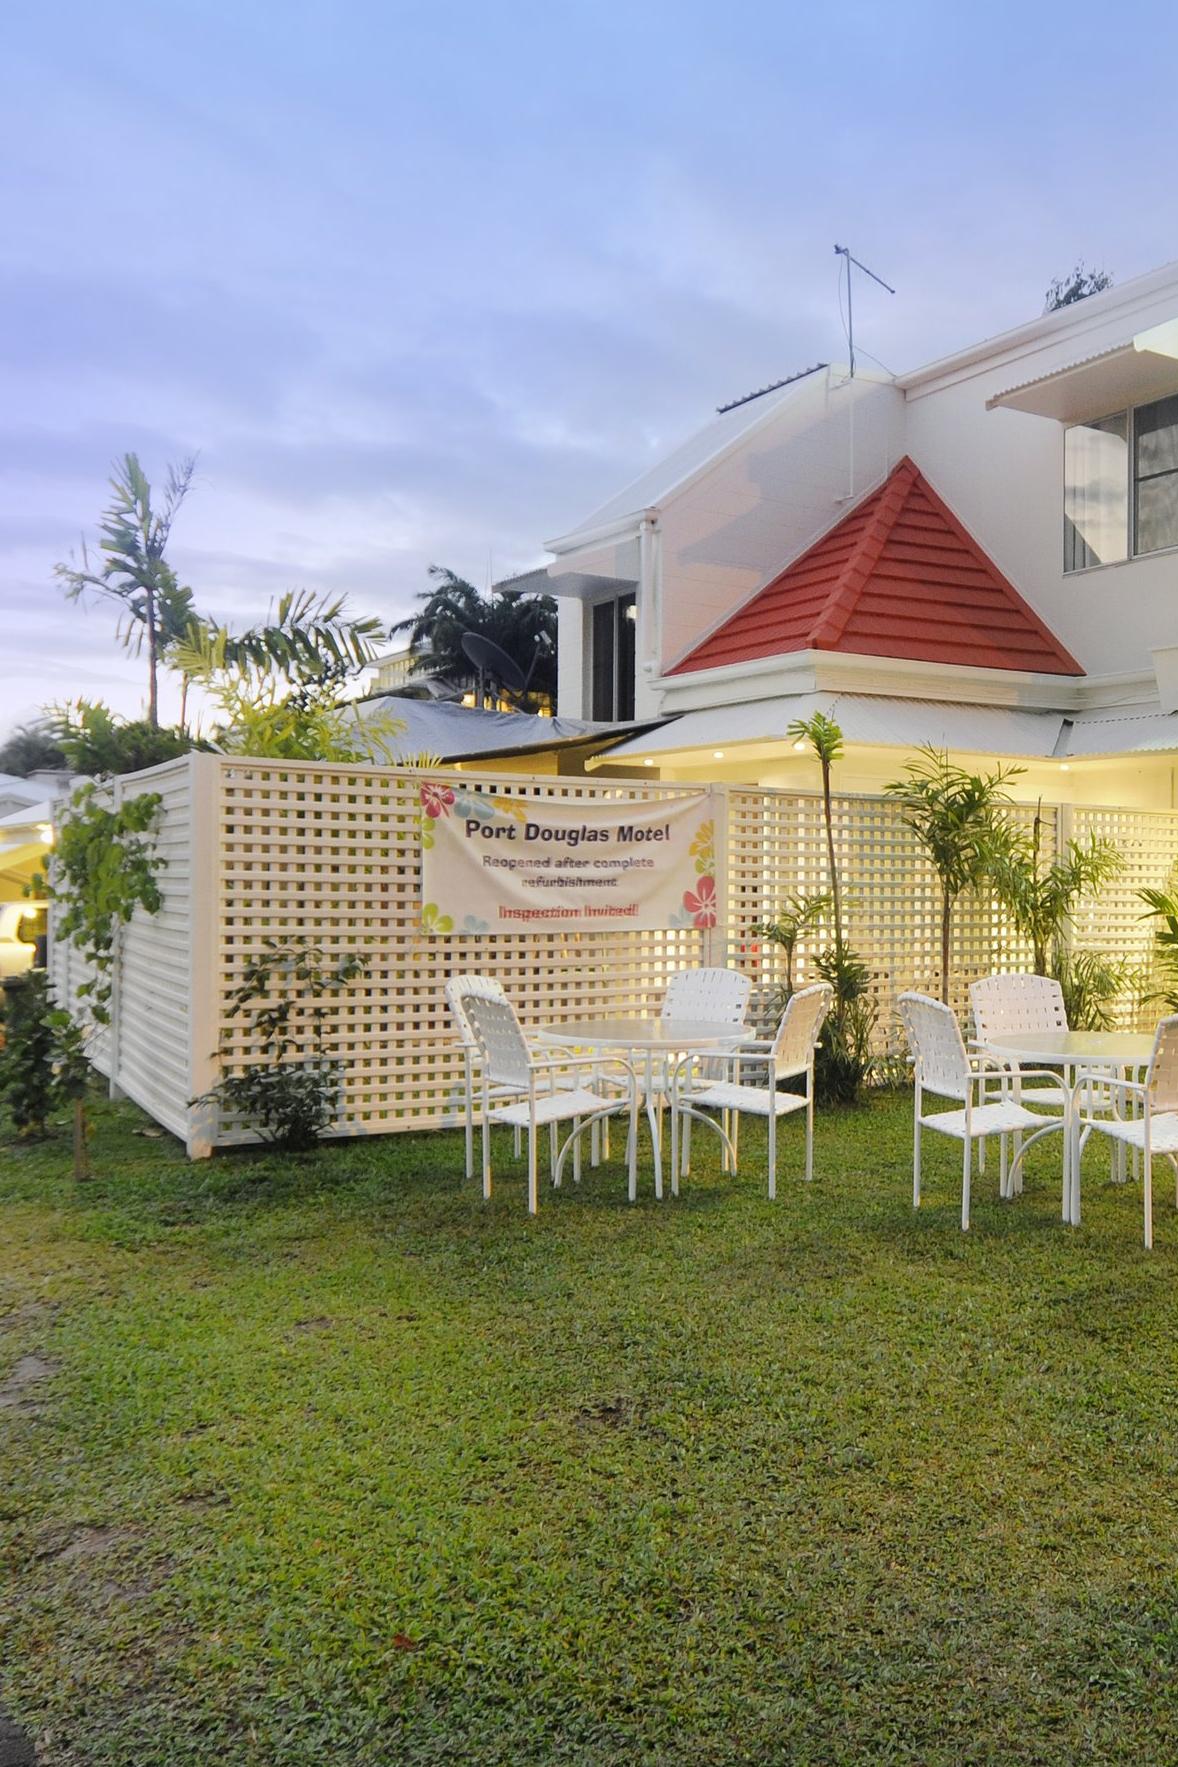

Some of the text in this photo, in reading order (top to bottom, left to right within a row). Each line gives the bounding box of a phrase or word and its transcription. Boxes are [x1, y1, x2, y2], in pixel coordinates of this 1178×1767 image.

[465, 819, 670, 846] Port Douglas Motel
[482, 855, 655, 870] Reopened after complete
[521, 875, 618, 888] refurbishment
[499, 904, 581, 921] Inspection
